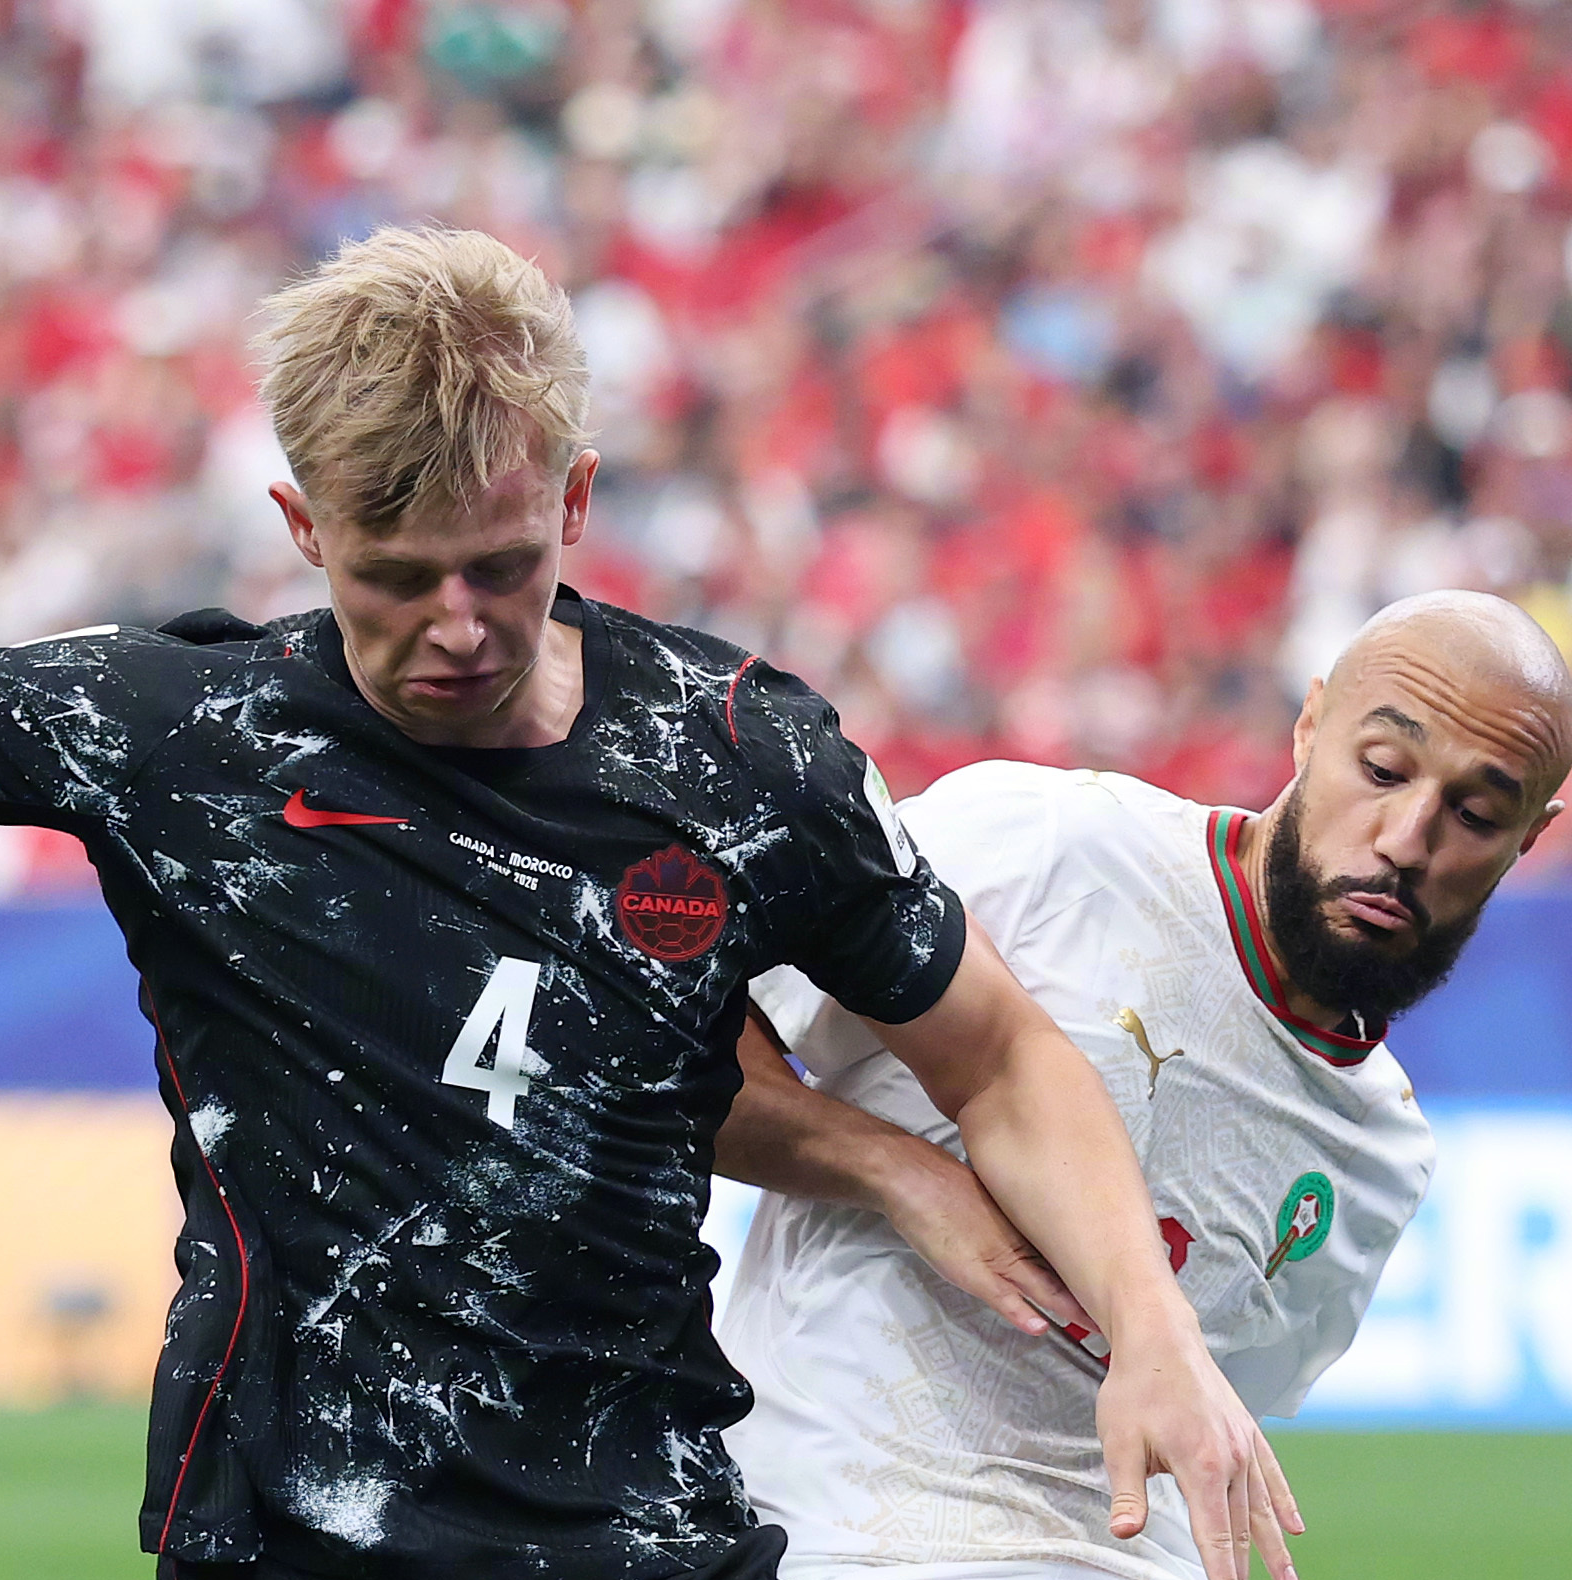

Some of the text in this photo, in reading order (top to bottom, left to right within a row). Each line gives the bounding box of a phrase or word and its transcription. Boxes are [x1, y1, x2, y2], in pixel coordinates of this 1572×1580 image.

[449, 832, 495, 858] CANADA
[509, 852, 573, 880] MOROCCO
[513, 872, 539, 891] 2026
[622, 895, 720, 918] CANADA
[441, 956, 542, 1130] 4
